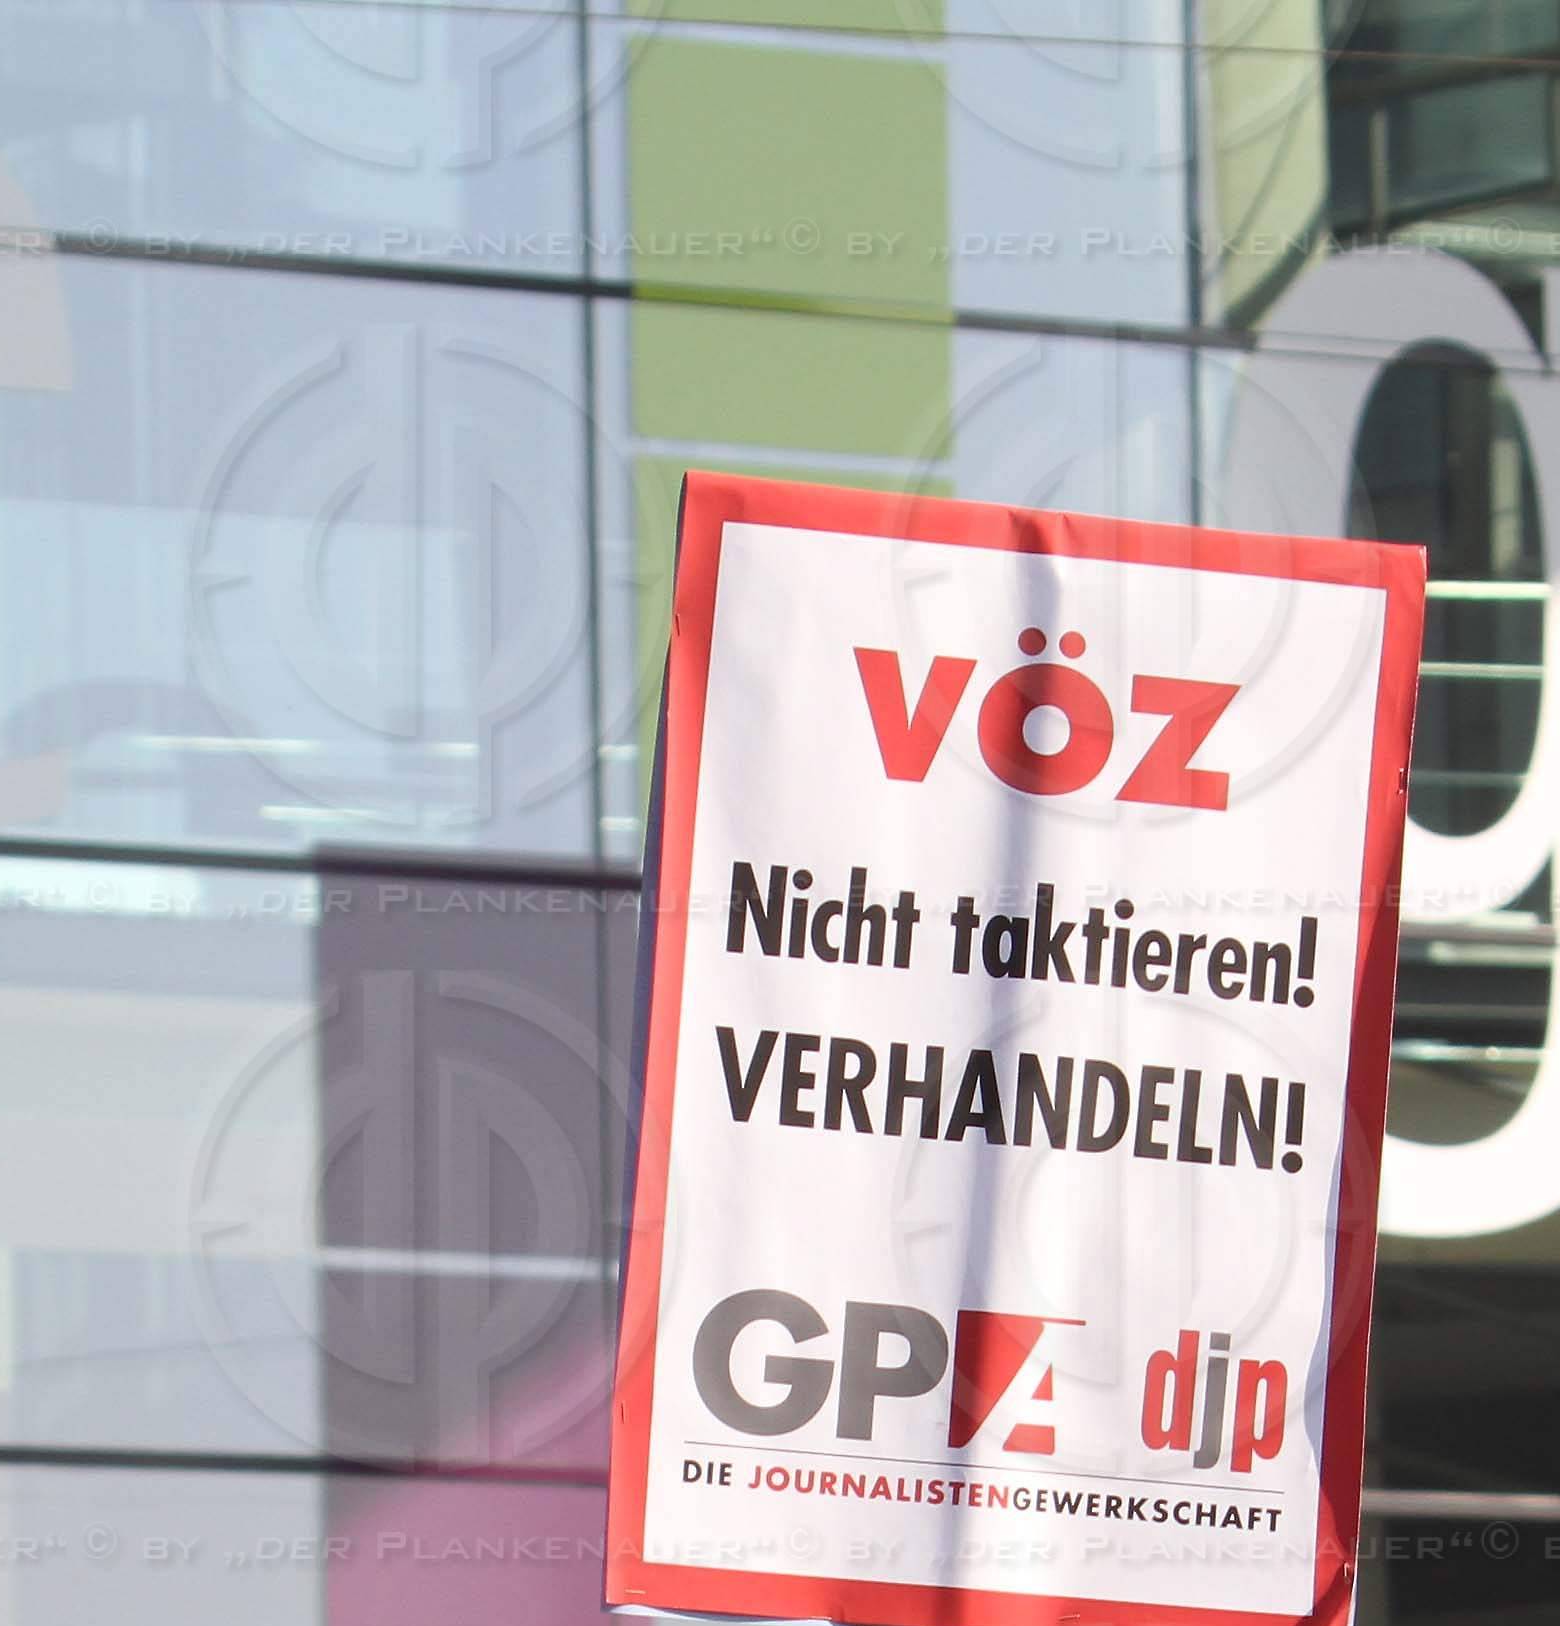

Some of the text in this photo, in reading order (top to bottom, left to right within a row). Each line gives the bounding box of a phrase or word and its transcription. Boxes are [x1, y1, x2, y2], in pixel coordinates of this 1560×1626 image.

[852, 626, 1242, 812] VÖZ
[725, 861, 1319, 1010] Nicht taktieren!
[714, 1026, 1307, 1175] VERHANDELN!
[692, 1288, 1290, 1474] GPA djp
[681, 1458, 1283, 1533] DIE JOURNALISTENGEWERKSCHAFT
